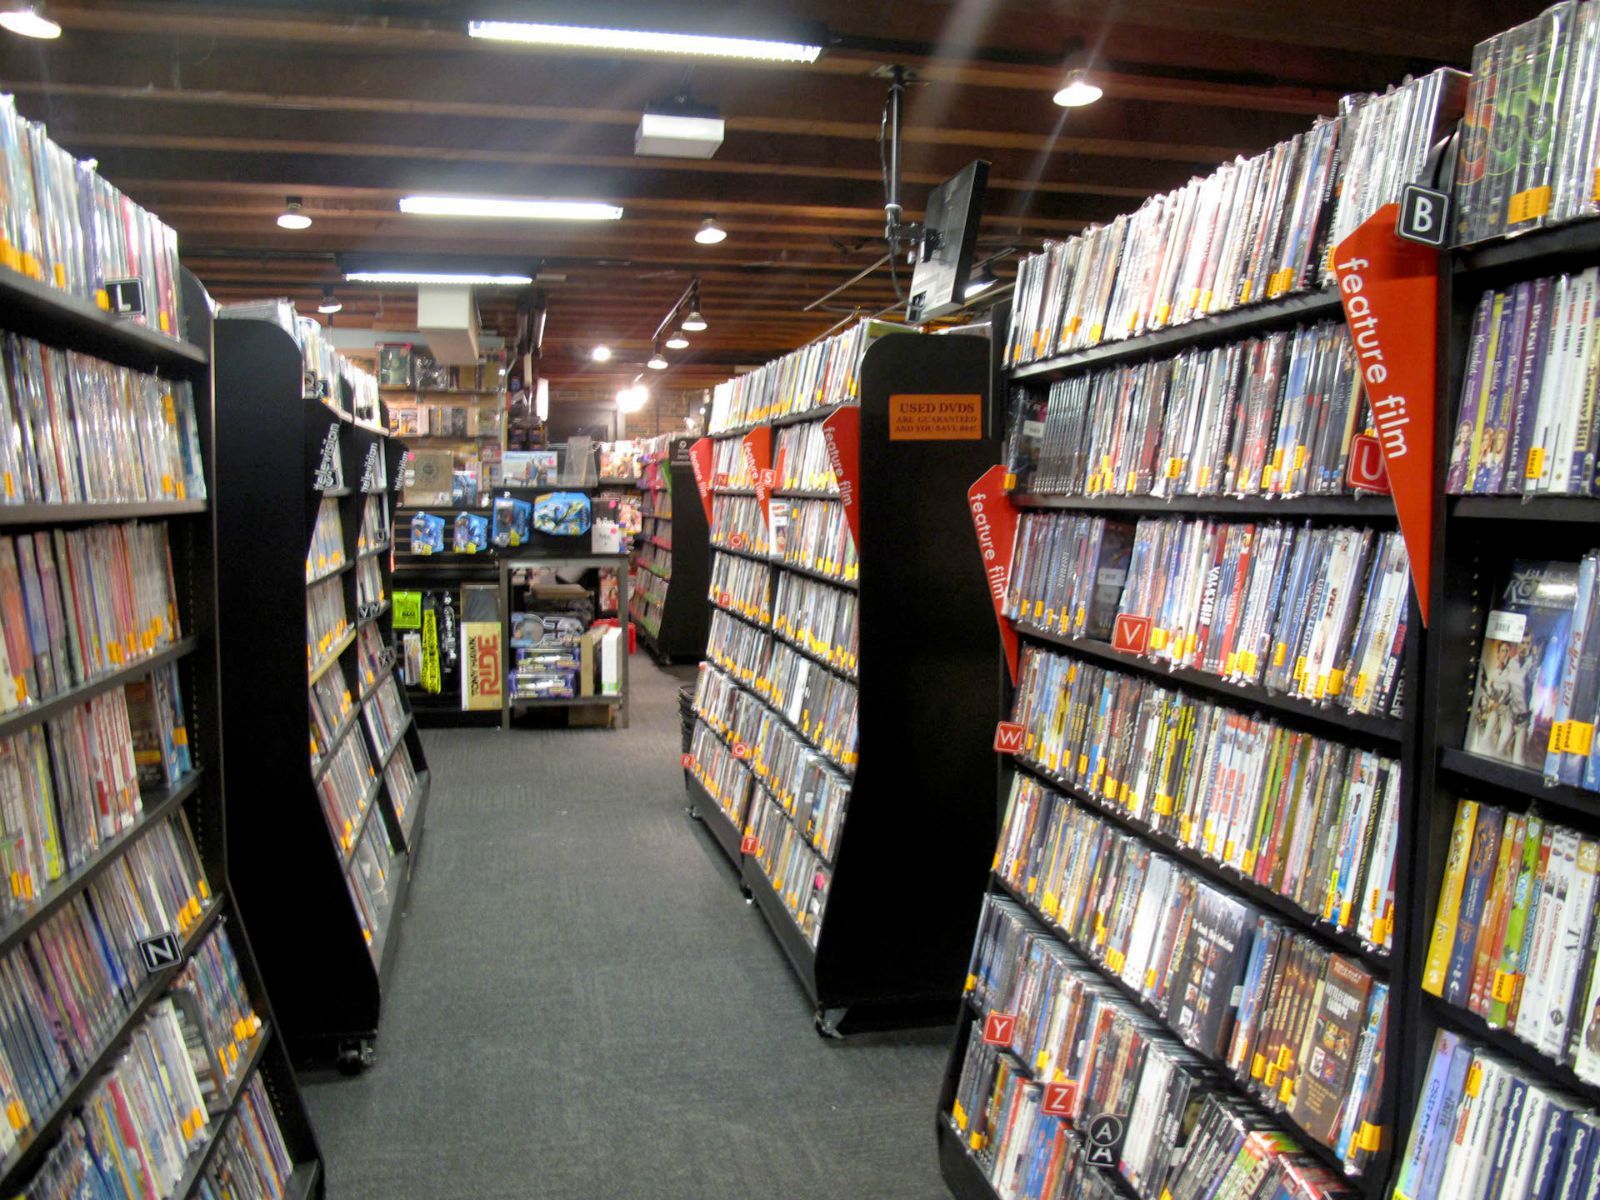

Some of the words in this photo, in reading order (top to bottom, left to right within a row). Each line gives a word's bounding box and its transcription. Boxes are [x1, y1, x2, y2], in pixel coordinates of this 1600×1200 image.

[1413, 196, 1432, 233] B
[114, 285, 131, 312] L
[1338, 257, 1387, 384] feature
[1375, 395, 1410, 458] film
[900, 402, 936, 414] USED
[940, 402, 975, 414] DVDS
[896, 425, 914, 433] AND
[1576, 416, 1589, 448] Hill
[824, 426, 844, 477] feature
[840, 480, 852, 506] film
[1363, 446, 1383, 481] U
[971, 493, 996, 561] feature
[989, 565, 1008, 599] film
[1310, 577, 1323, 616] URBAN
[1123, 620, 1141, 645] V
[1301, 619, 1314, 655] LEGEN
[468, 636, 476, 665] HAWK
[478, 634, 500, 697] RIDE
[468, 667, 476, 697] TONY
[999, 729, 1021, 744] W
[1565, 927, 1581, 951] TV
[147, 943, 173, 967] N
[1495, 973, 1506, 998] used
[993, 1019, 1008, 1038] Y
[1051, 1088, 1069, 1109] Z
[1096, 1122, 1113, 1140] A
[1092, 1149, 1113, 1163] A
